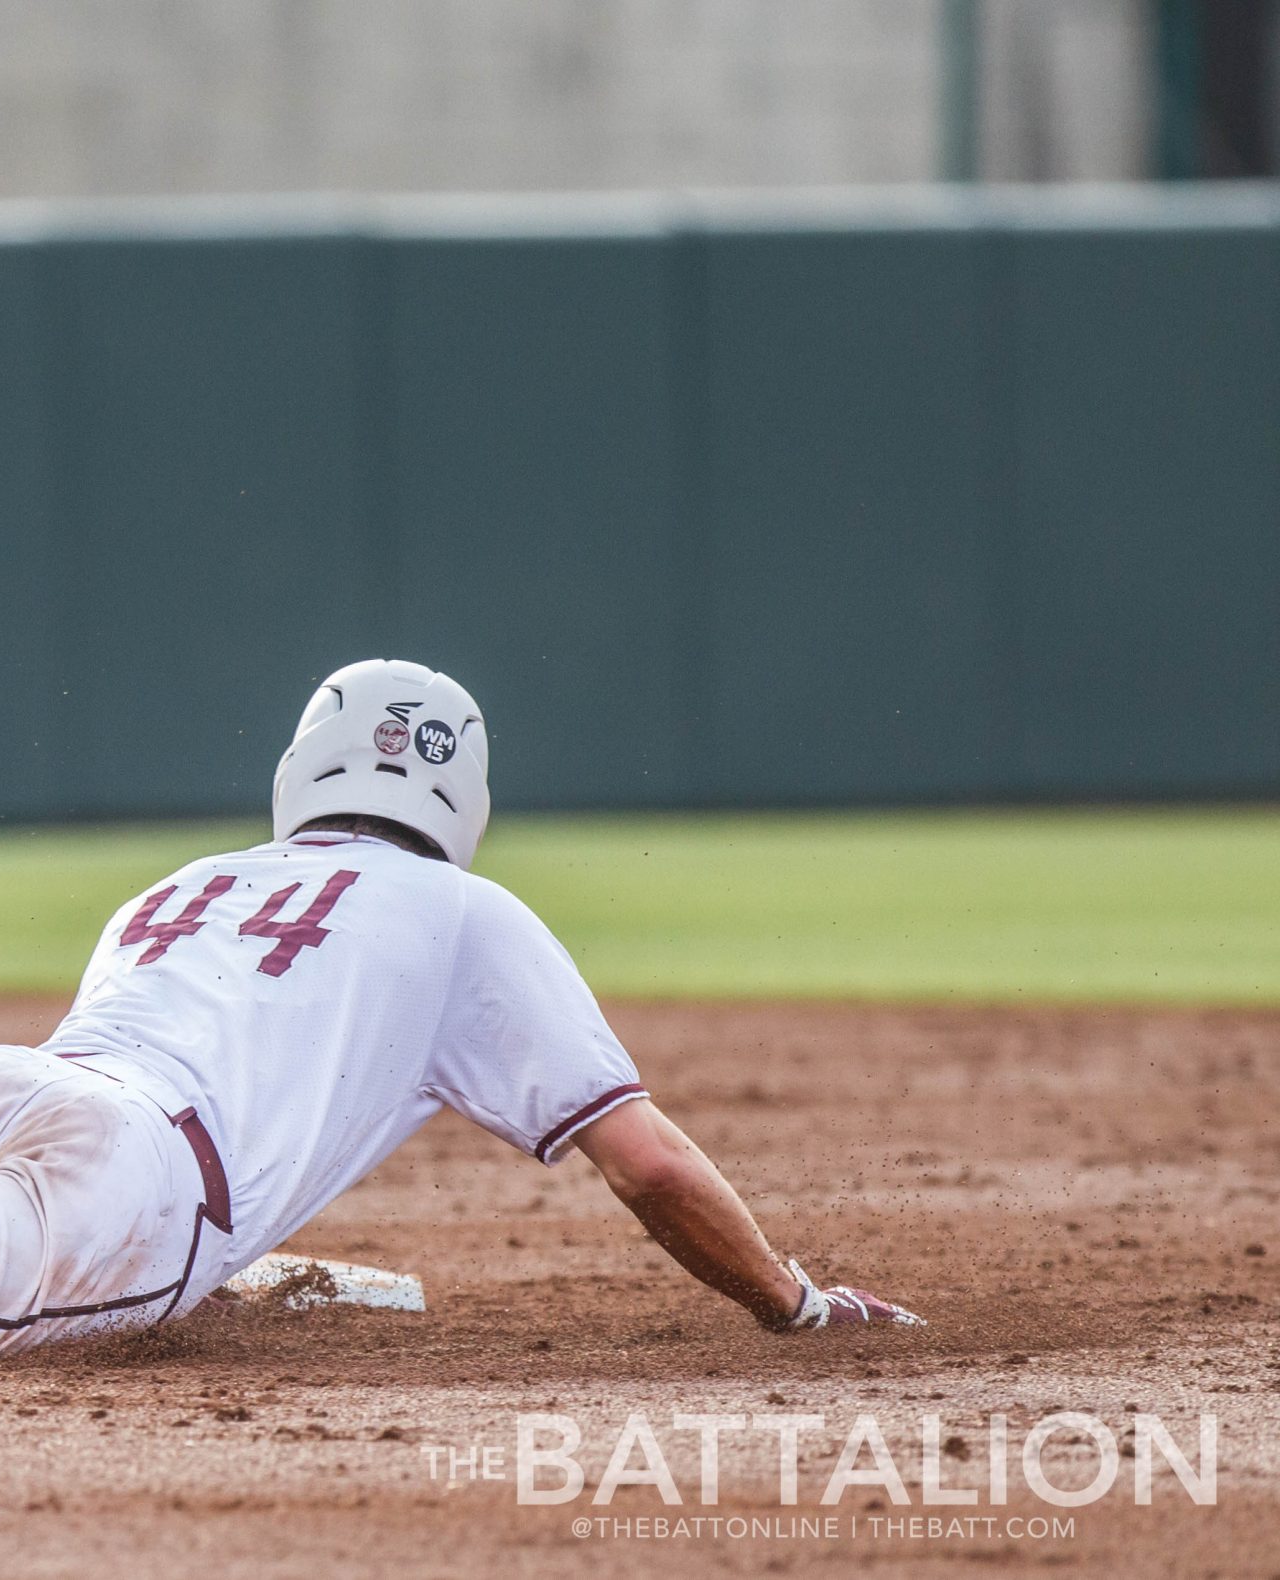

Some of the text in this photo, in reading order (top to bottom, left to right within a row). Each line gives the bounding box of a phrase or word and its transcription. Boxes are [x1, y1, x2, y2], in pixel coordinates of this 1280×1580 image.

[421, 726, 454, 750] WM
[426, 744, 444, 762] 15
[120, 870, 361, 978] 44
